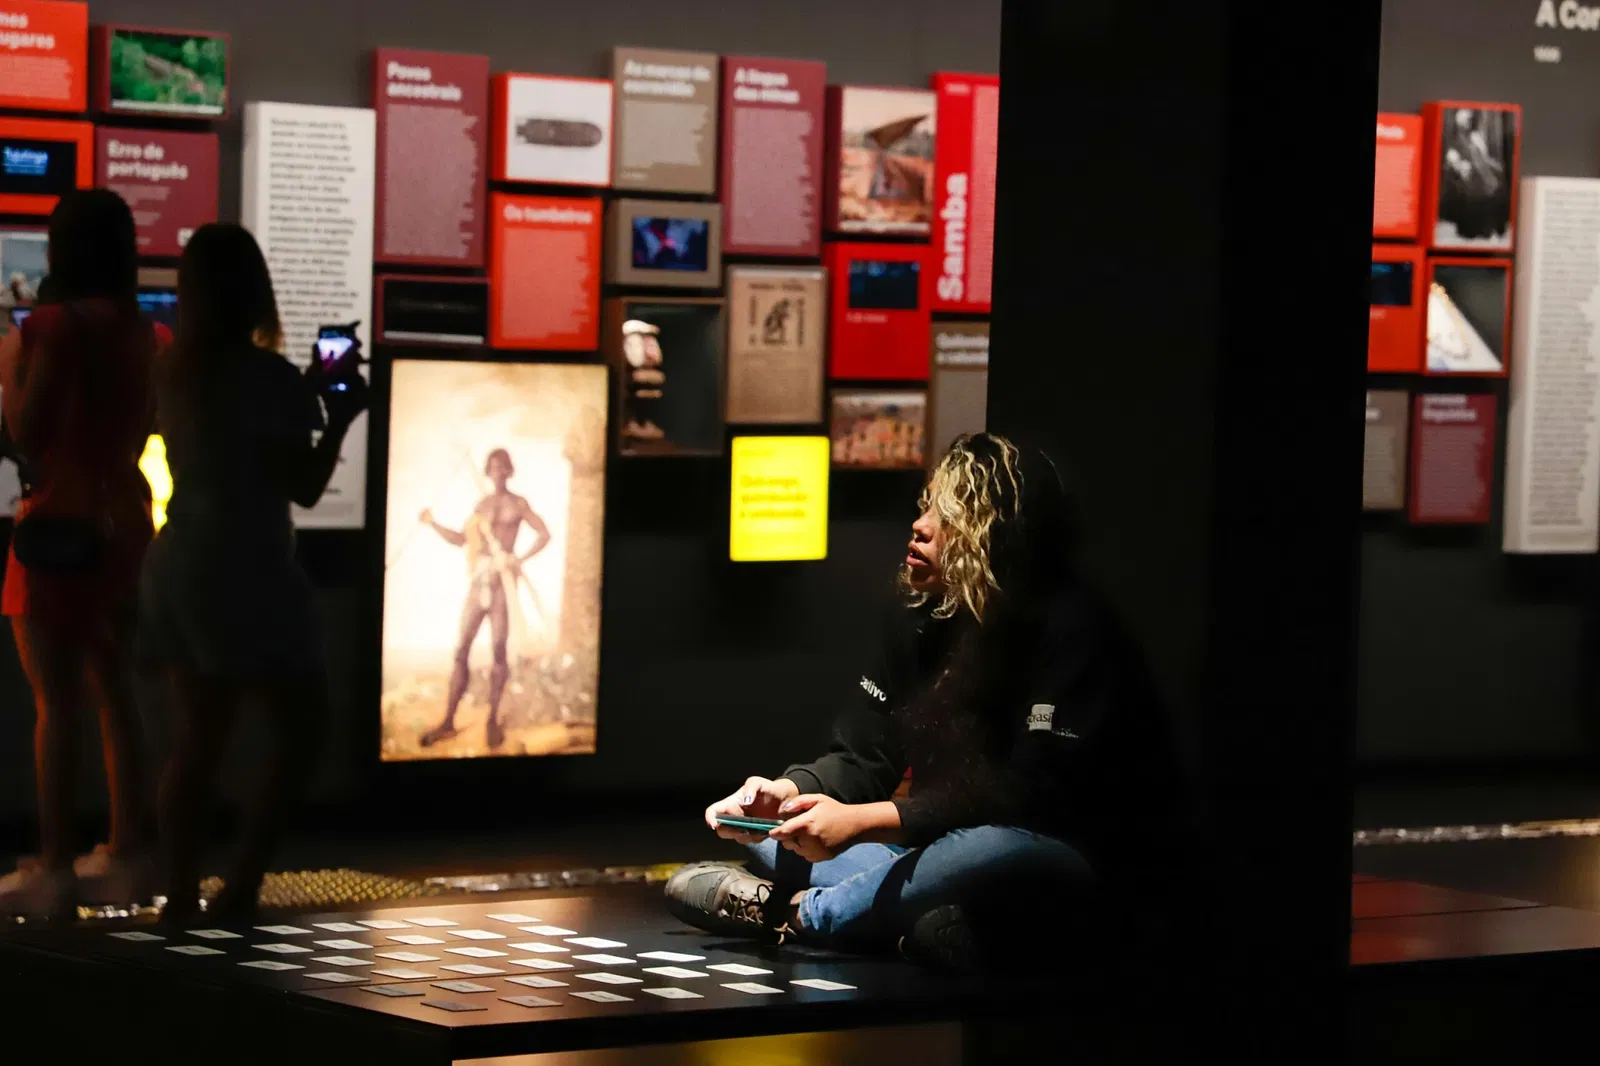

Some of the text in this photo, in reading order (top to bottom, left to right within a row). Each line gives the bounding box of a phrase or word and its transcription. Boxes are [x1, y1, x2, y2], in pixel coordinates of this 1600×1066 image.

[1535, 0, 1557, 28] A
[107, 139, 164, 160] Erro de
[107, 161, 188, 180] português
[937, 172, 968, 300] Samba
